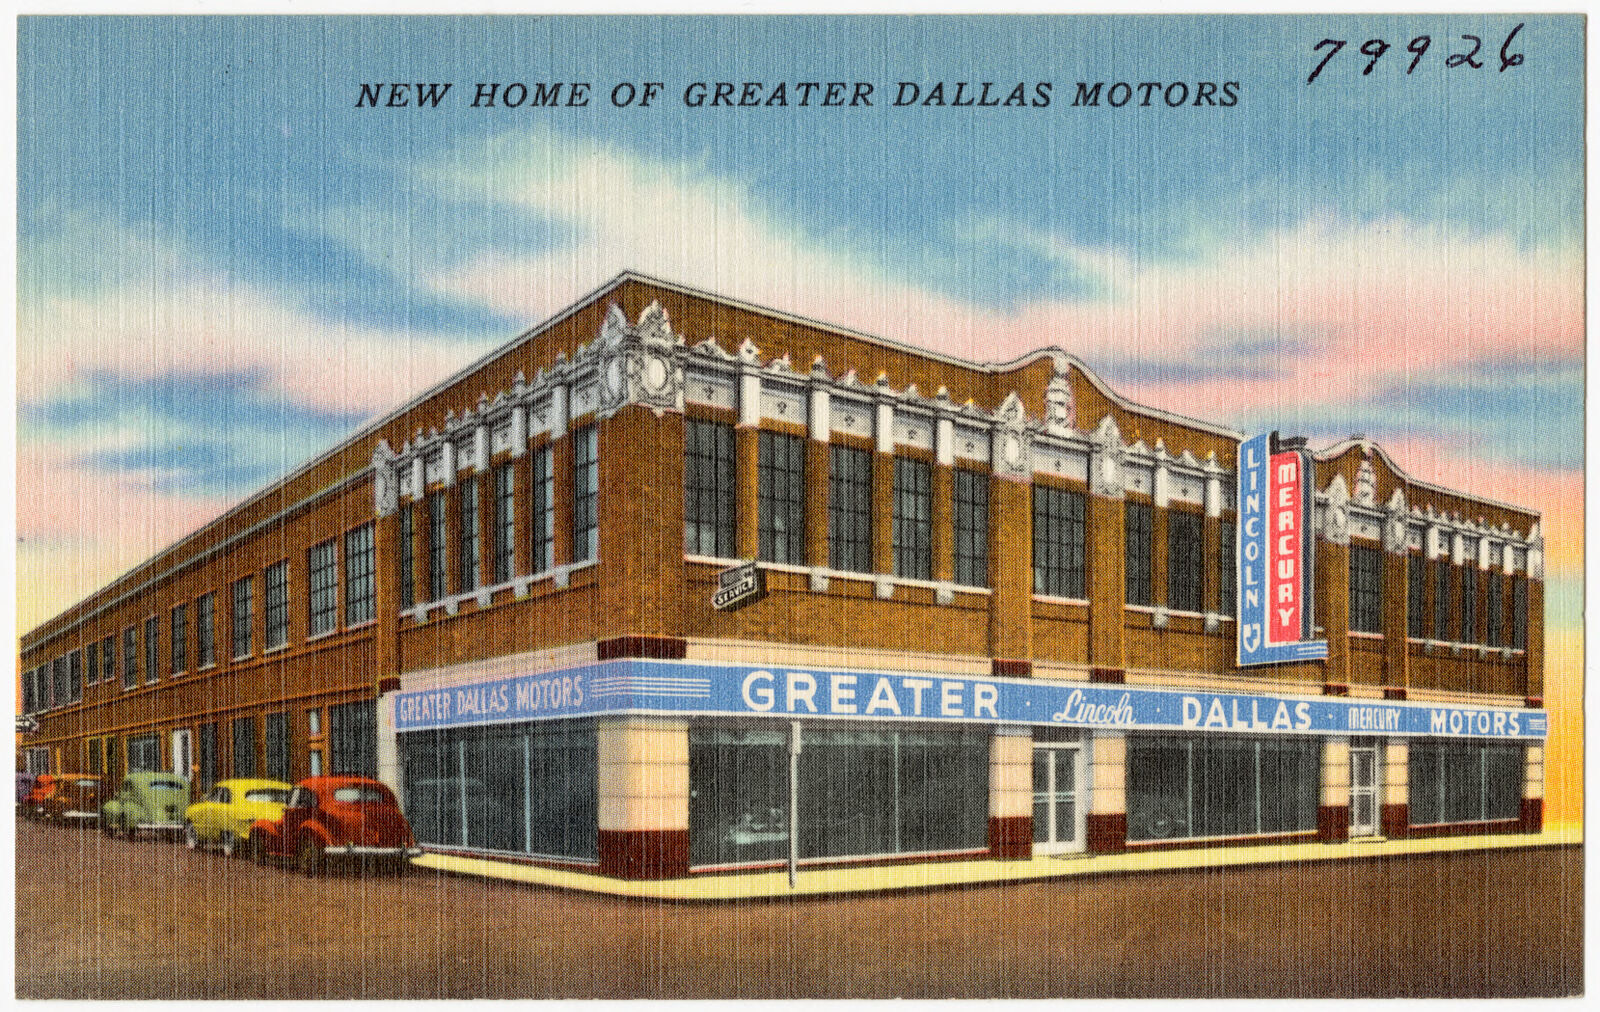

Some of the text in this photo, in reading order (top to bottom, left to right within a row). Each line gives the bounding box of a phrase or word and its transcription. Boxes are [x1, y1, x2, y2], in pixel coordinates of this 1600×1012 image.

[1306, 22, 1525, 85] 79926
[1244, 447, 1262, 609] LINCOLN
[1277, 462, 1297, 627] MERCURY
[400, 675, 585, 722] GREATER DALLAS MOTORS
[741, 670, 1521, 736] GREATER Lincoln DALLAS MERCURY MOTORS
